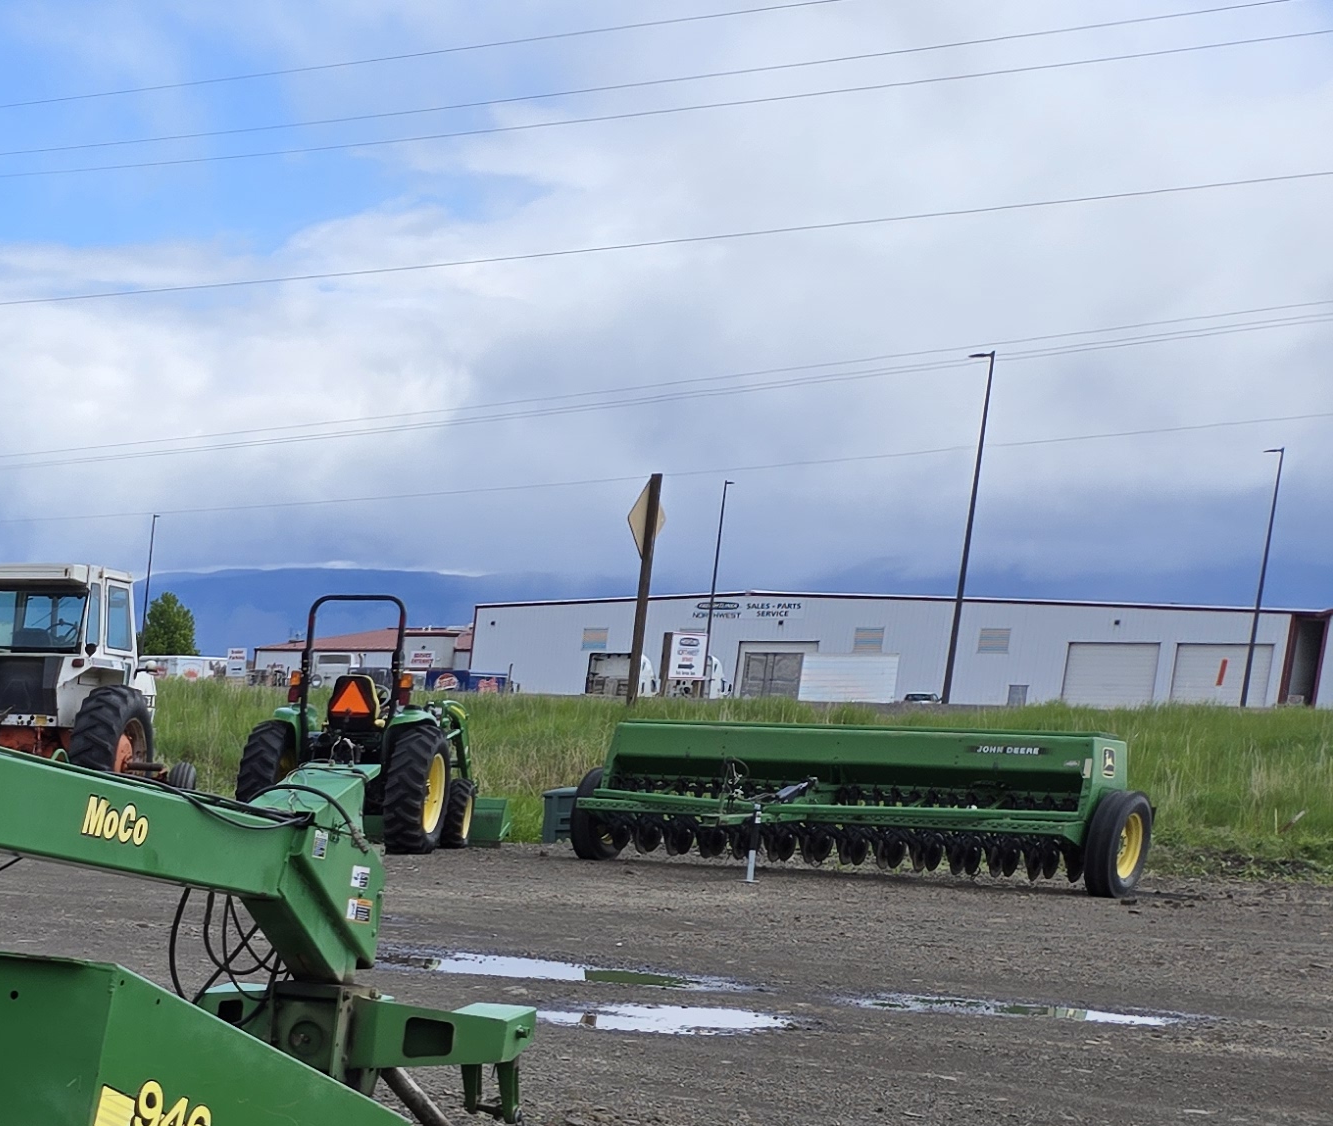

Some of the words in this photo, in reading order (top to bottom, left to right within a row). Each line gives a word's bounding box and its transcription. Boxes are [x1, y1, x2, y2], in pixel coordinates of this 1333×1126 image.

[976, 745, 1004, 753] JOHN
[1006, 746, 1039, 755] DEERE
[80, 794, 149, 847] MoCo
